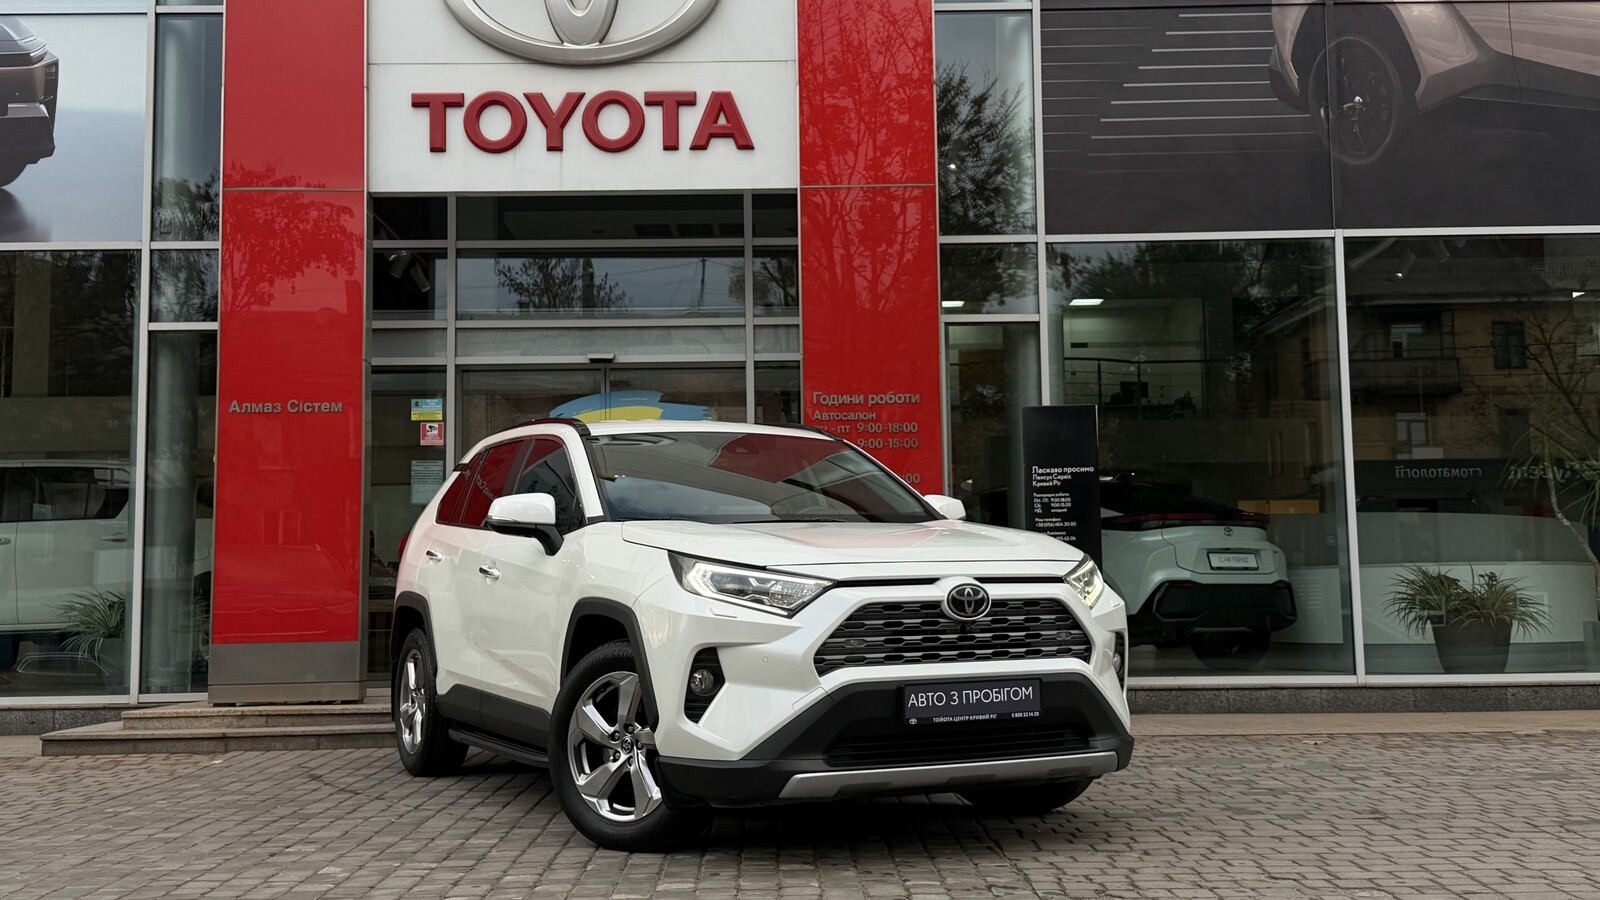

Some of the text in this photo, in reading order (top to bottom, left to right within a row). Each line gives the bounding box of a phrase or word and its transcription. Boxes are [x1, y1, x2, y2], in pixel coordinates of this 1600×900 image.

[411, 90, 755, 153] TOYOTA
[228, 399, 343, 413] Алмаз Сістем
[812, 391, 920, 407] Години роботи
[812, 410, 876, 420] Автосалон
[856, 422, 918, 432] 9:00-18:00
[858, 438, 918, 448] 9:00-15:00
[908, 686, 1032, 708] АВТО З ПРОБІГОМ
